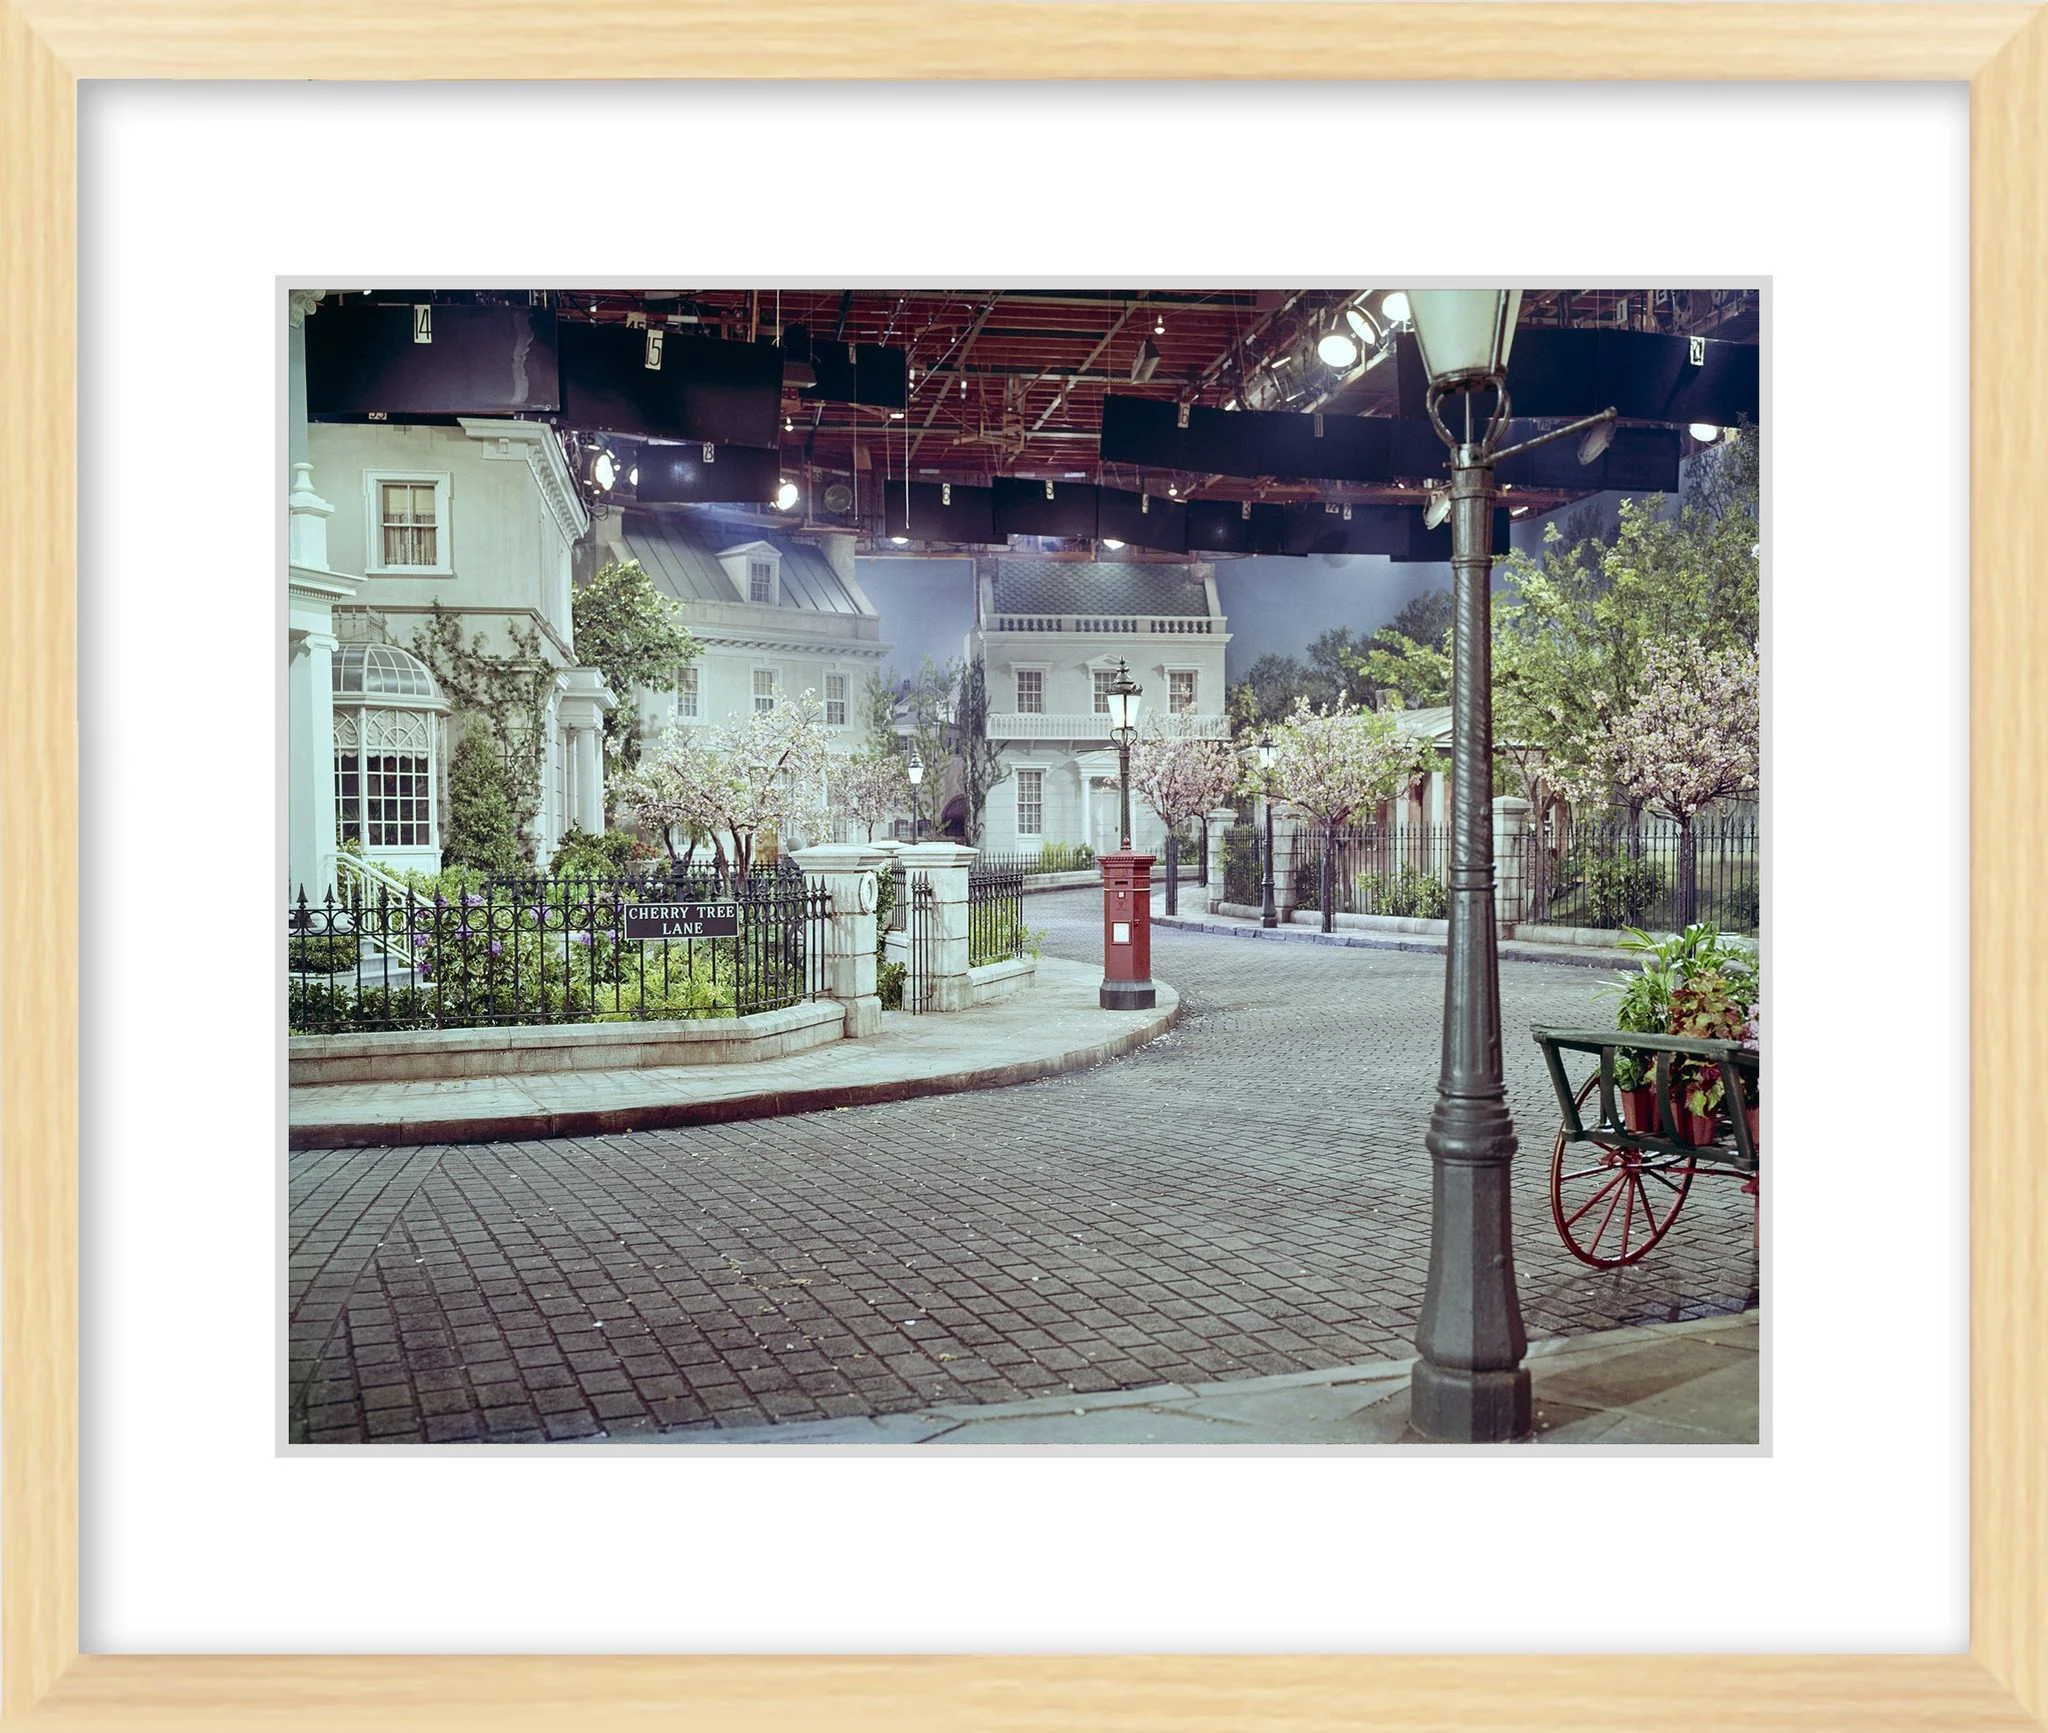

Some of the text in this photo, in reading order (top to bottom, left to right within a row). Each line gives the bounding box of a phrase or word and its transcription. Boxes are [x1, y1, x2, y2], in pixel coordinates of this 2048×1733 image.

[415, 308, 431, 340] 14
[645, 337, 663, 366] 15
[578, 432, 596, 445] 65
[629, 906, 735, 920] CHERRY TREE
[663, 922, 703, 935] LANE
